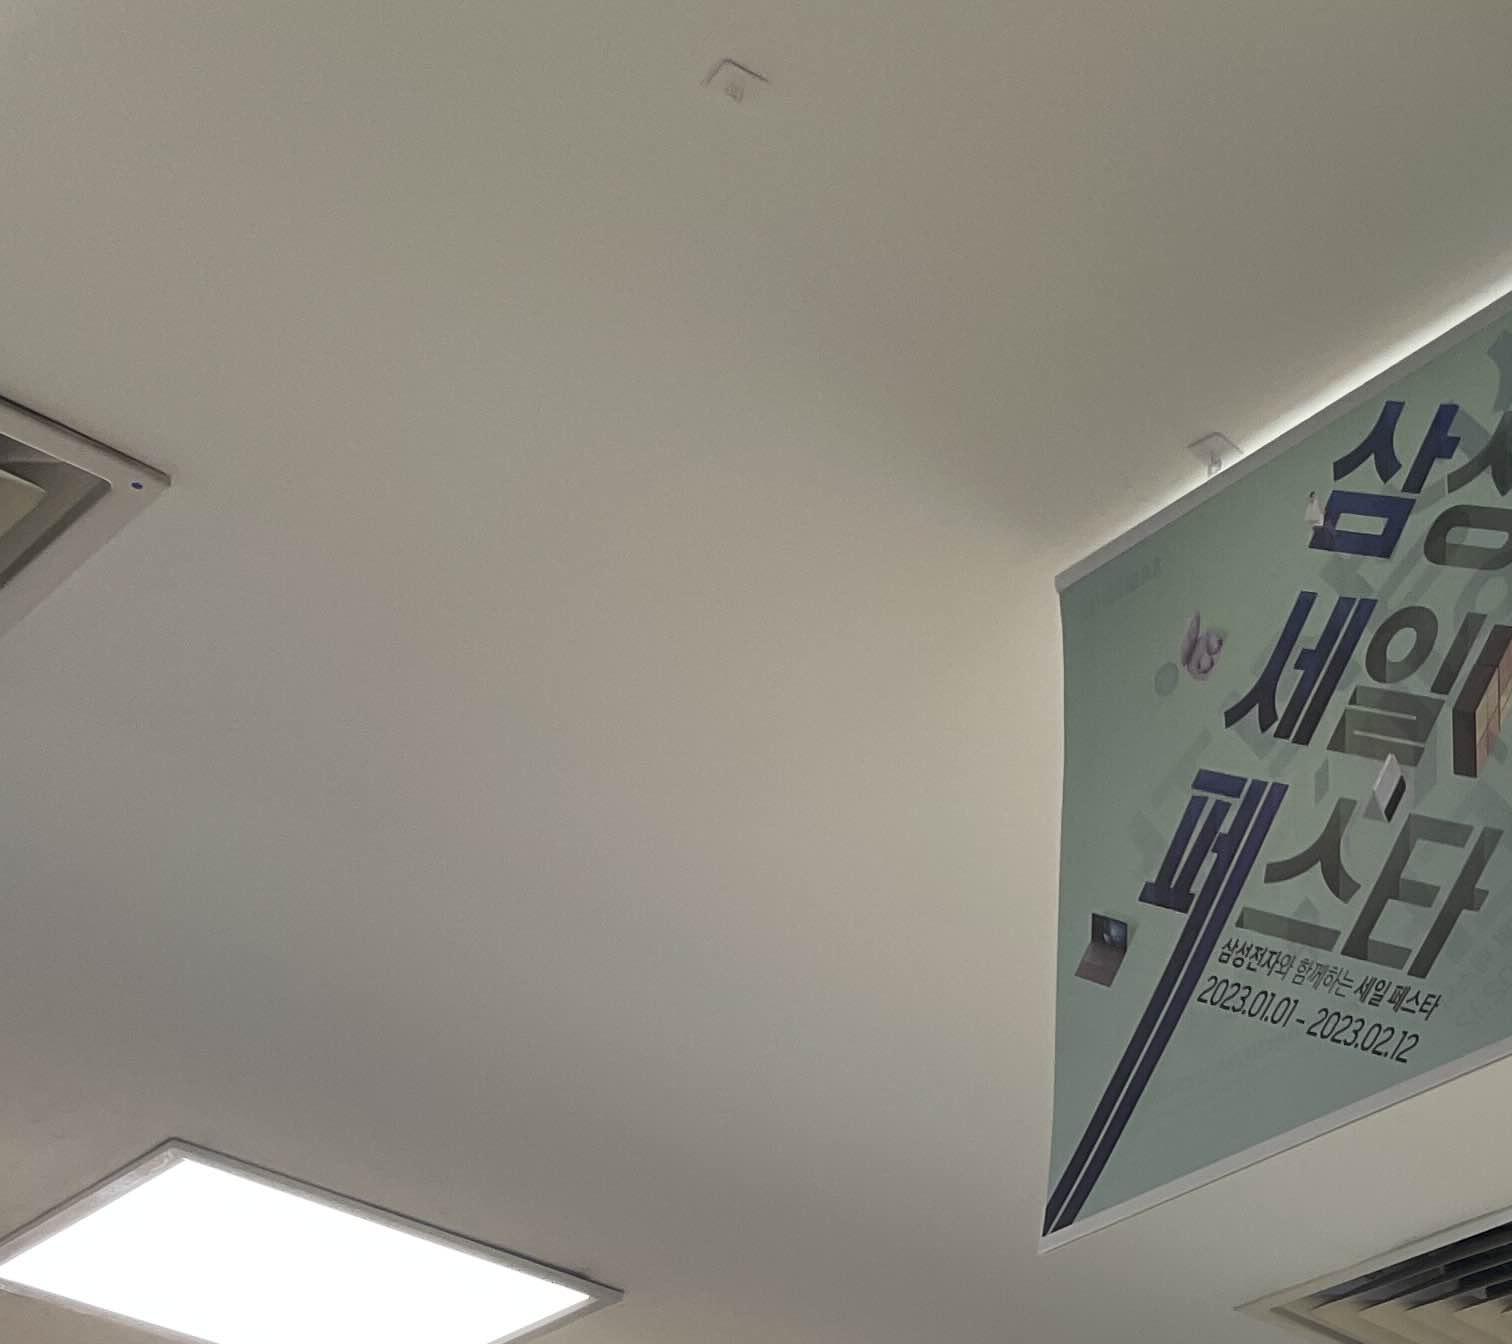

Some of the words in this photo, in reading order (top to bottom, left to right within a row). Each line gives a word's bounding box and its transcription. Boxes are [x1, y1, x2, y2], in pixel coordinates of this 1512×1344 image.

[1196, 975, 1300, 1028] 2023.01.01
[1306, 1008, 1419, 1063] 2023.02.12
[1218, 938, 1297, 981] 삼성전자와
[1291, 958, 1354, 998] 함께하는
[1354, 975, 1392, 1008] 세일
[1387, 985, 1442, 1021] 페스타
